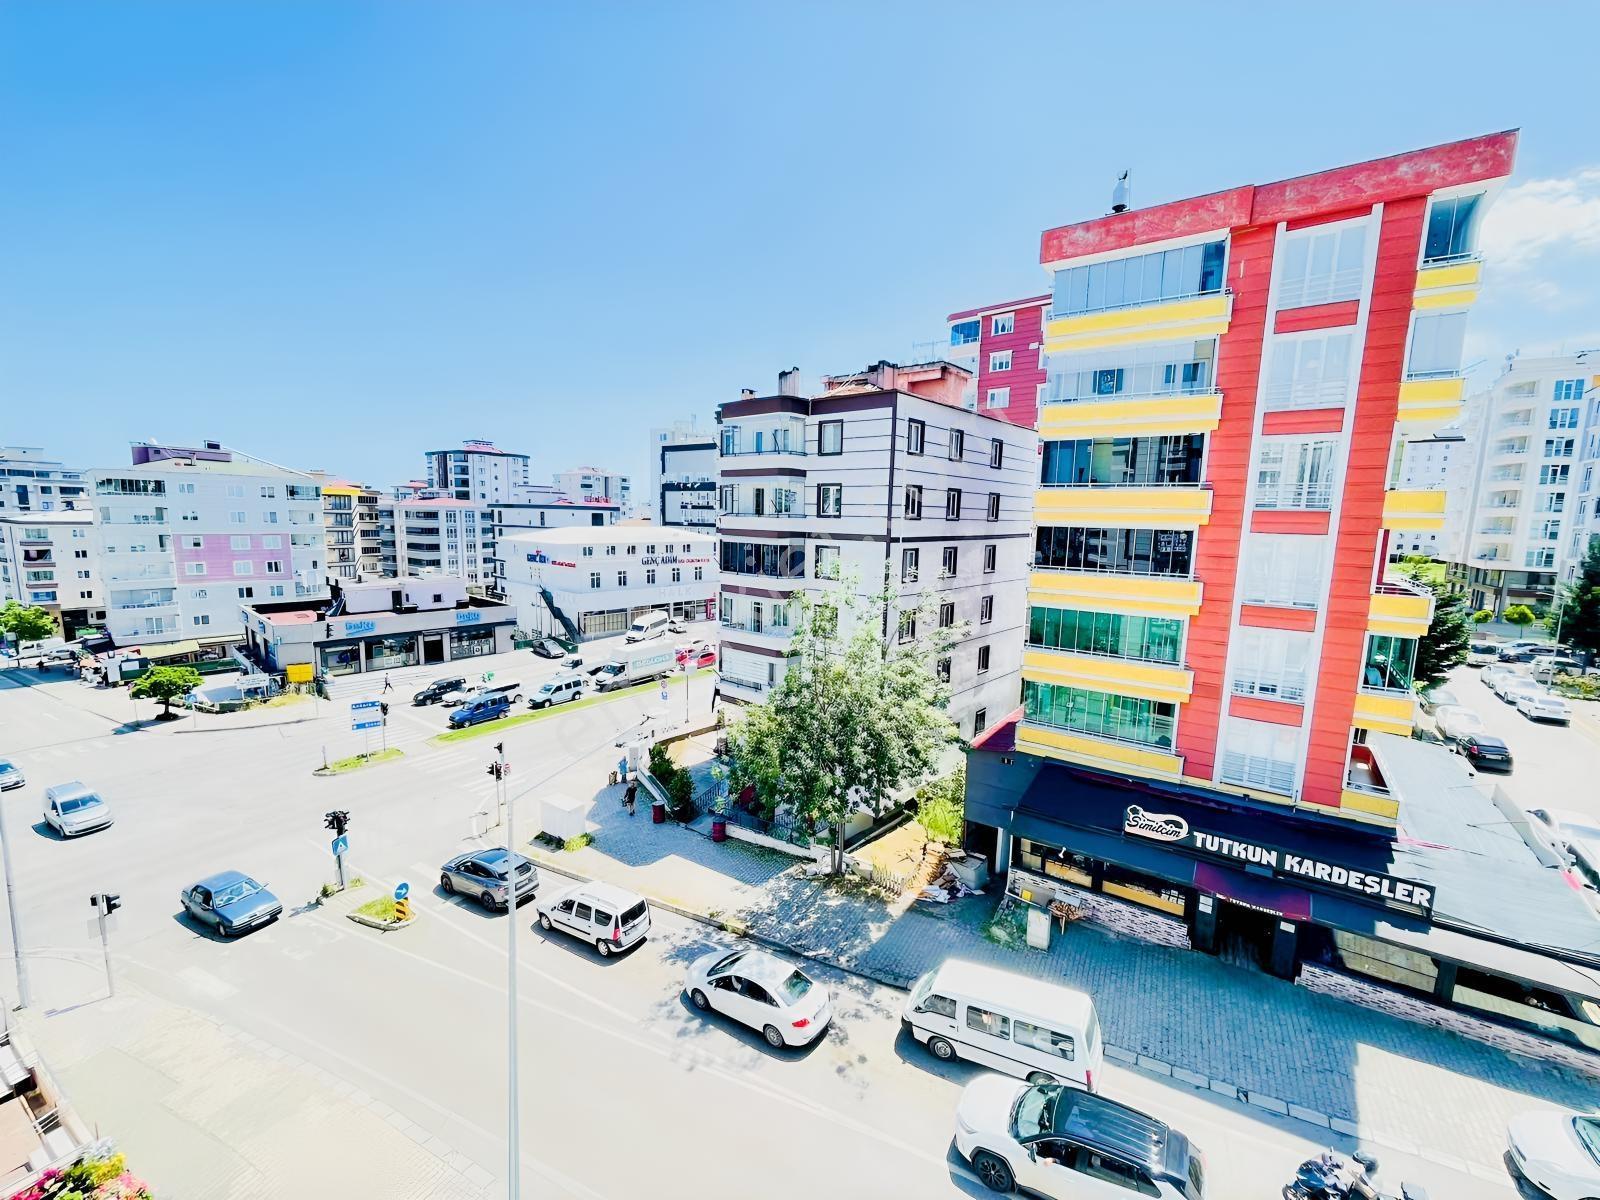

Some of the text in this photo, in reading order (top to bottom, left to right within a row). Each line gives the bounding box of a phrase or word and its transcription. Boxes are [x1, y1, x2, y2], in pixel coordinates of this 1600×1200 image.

[641, 557, 660, 566] GENÇ
[1193, 831, 1432, 907] TUTKUN KARDEŞLER
